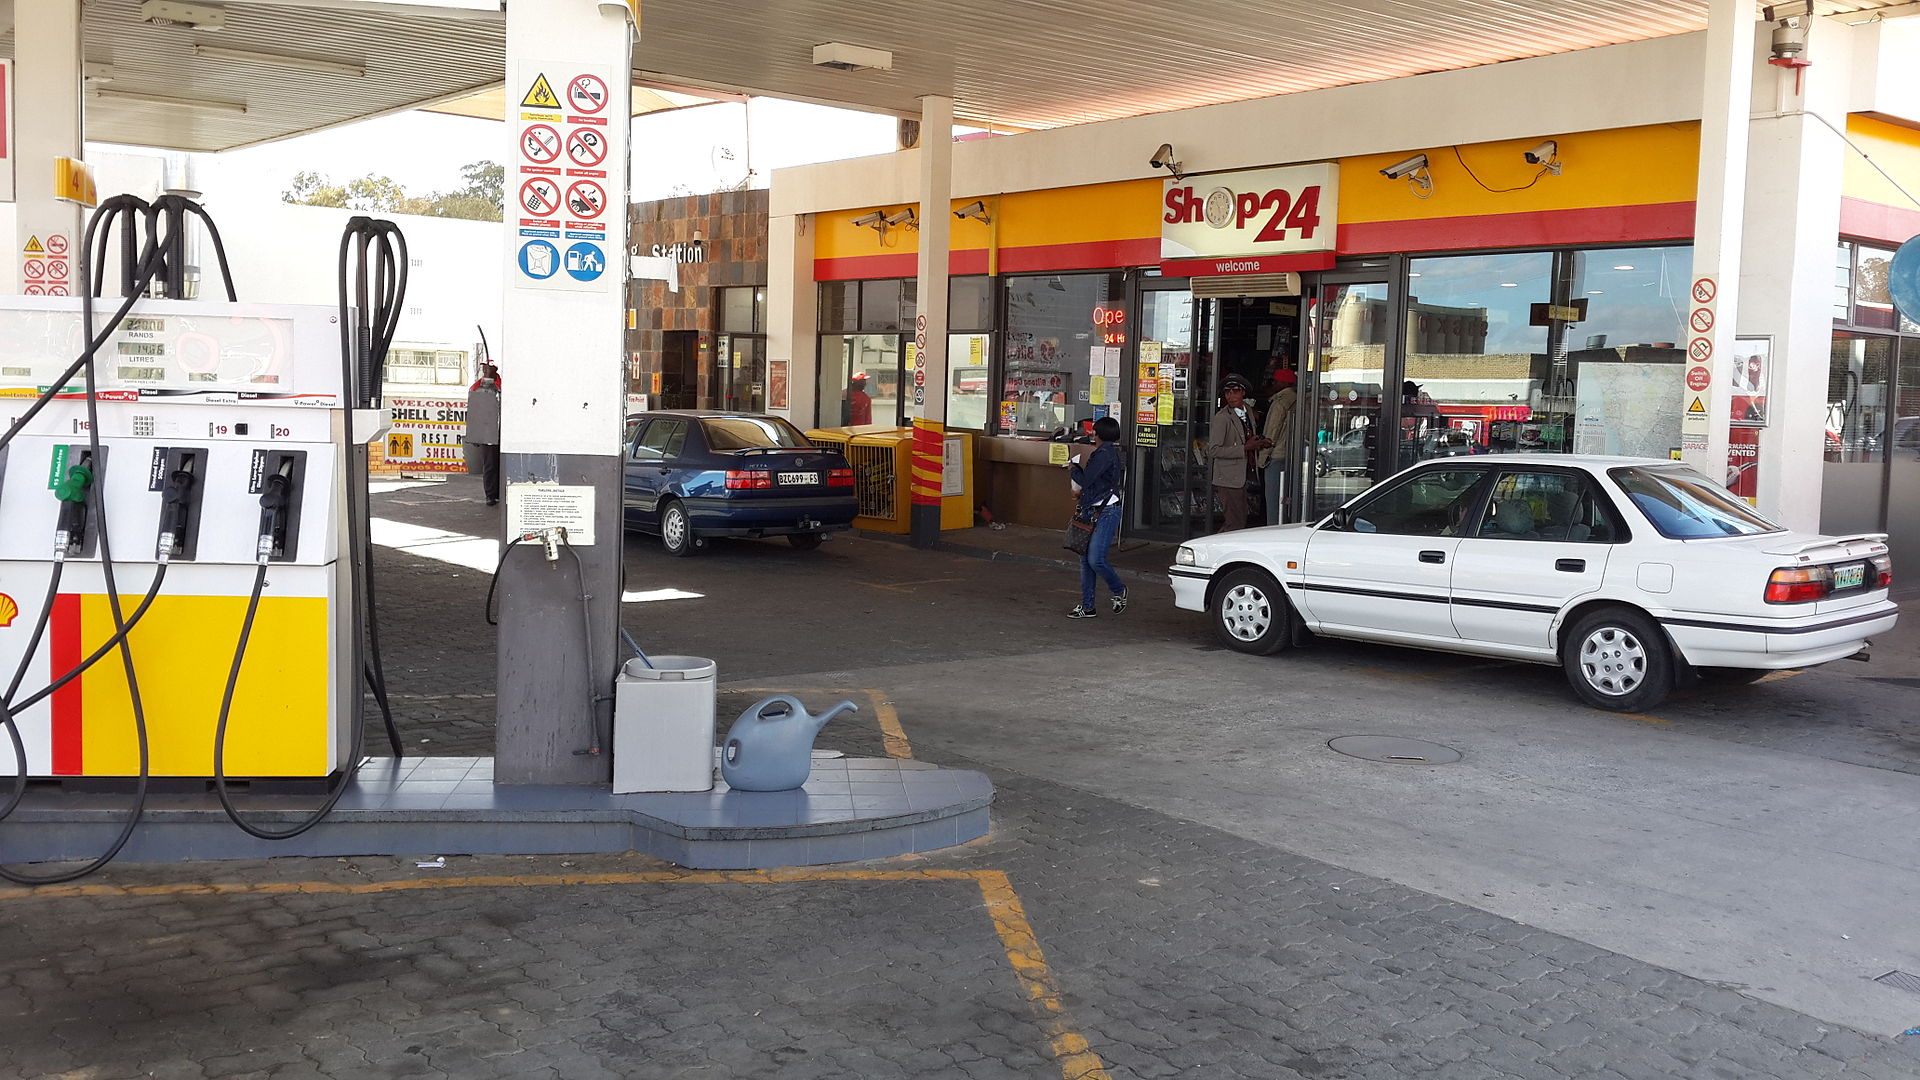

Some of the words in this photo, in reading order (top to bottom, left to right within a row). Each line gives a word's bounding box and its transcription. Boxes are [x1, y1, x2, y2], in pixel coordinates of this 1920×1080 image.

[652, 243, 702, 263] Station
[1216, 260, 1260, 273] welcome
[1104, 333, 1114, 343] 24
[392, 400, 468, 408] WELCOME
[392, 408, 430, 420] SHELL
[79, 421, 91, 430] 18
[215, 425, 227, 434] 19
[275, 428, 290, 437] 20
[421, 433, 448, 444] REST
[426, 447, 456, 459] SHELL
[1727, 449, 1756, 457] VENTED
[809, 474, 818, 483] FS
